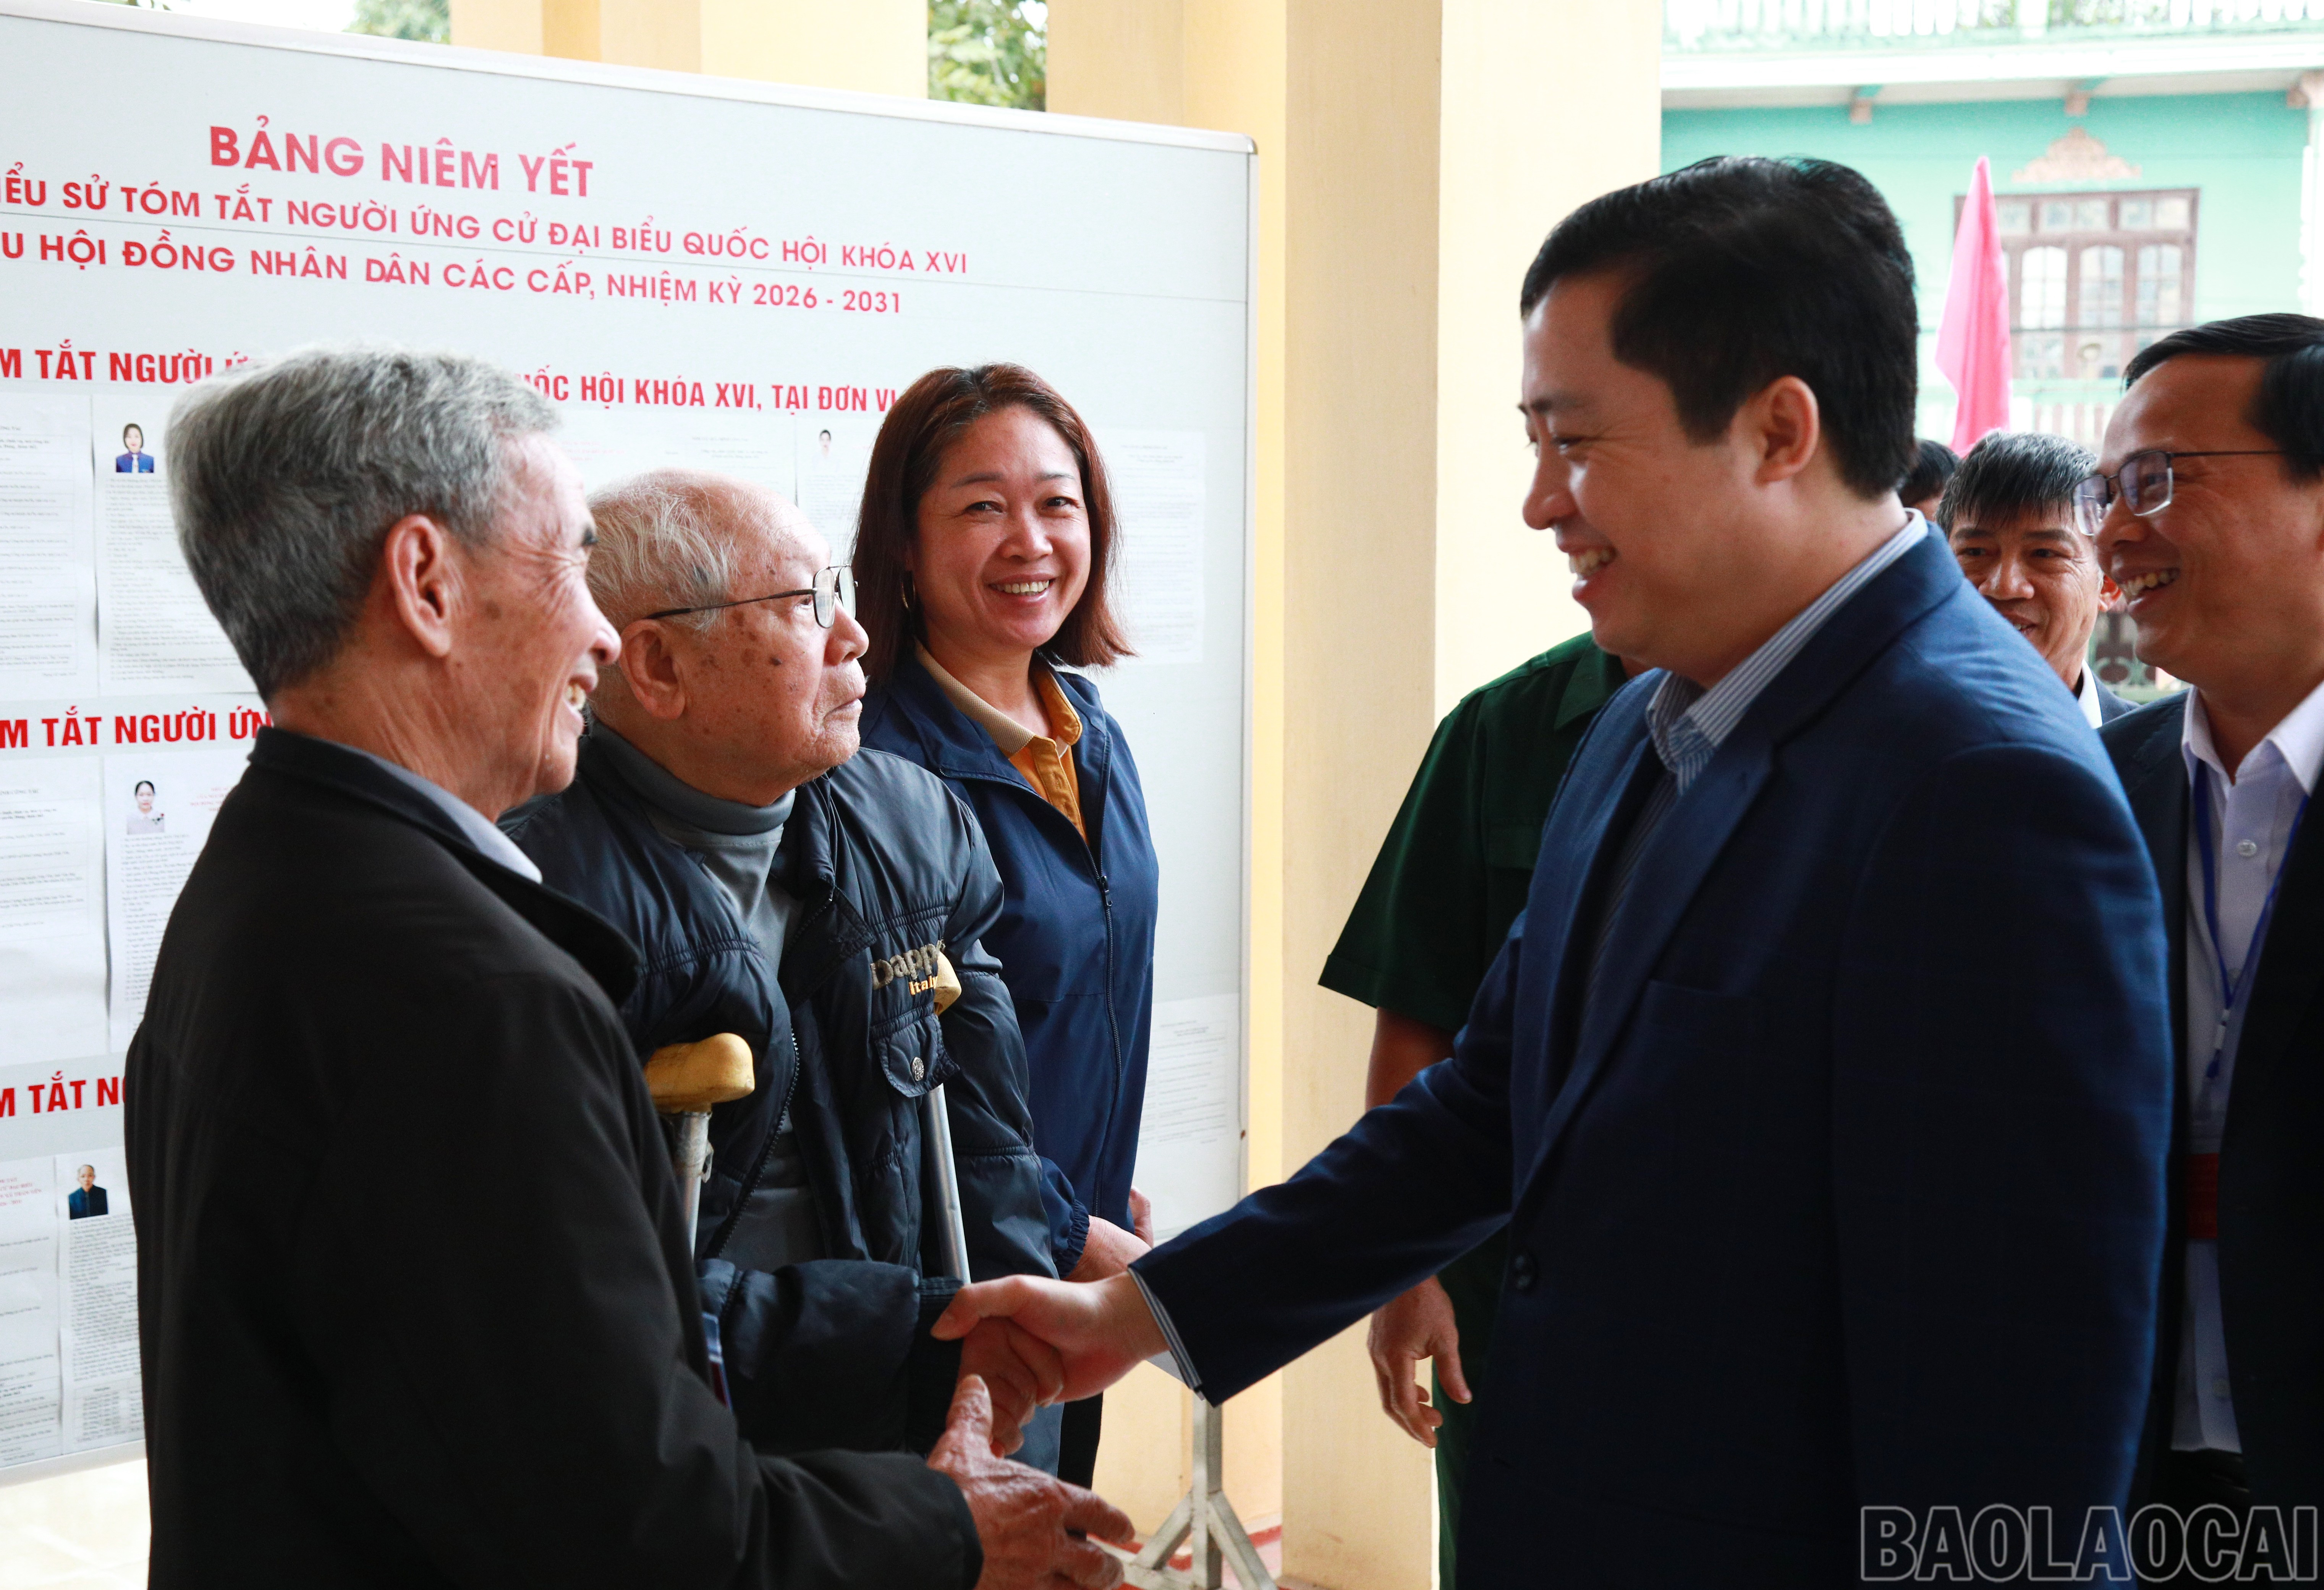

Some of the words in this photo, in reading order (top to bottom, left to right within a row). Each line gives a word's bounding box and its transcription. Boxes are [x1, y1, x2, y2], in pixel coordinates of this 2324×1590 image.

[210, 115, 363, 176] BẢNG
[382, 138, 498, 189] NIÊM
[520, 143, 593, 196] YẾT
[0, 162, 46, 206] ỂU
[63, 174, 109, 210] SỬ
[121, 181, 200, 217] TÓM
[215, 183, 273, 222] TẮT
[288, 200, 396, 232] NGƯỜI
[411, 205, 480, 238] ỨNG
[493, 212, 537, 243] CỬ
[548, 223, 599, 254] ĐẠI
[613, 214, 671, 252] BIỂU
[683, 226, 769, 259] QUỐC
[783, 236, 826, 269] HỘI
[843, 243, 914, 270] KHÓA
[926, 252, 966, 273] XVI
[40, 229, 106, 270] HỘI
[122, 229, 235, 272] ĐỒNG
[251, 246, 346, 279] NHÂN
[366, 252, 429, 285] DÂN
[443, 259, 514, 290] CÁC
[528, 260, 594, 299] CẤP,
[608, 270, 696, 306] NHIỆM
[710, 281, 741, 303] KỲ
[754, 283, 817, 308] 2026
[843, 290, 898, 312] 2031
[35, 339, 96, 380] TẮT
[110, 349, 212, 383] NGƯỜI
[515, 365, 568, 401] ỐC
[581, 371, 623, 409] HỘI
[636, 376, 705, 406] KHÓA
[715, 383, 761, 411] XVI,
[772, 385, 808, 415] TẠI
[818, 385, 866, 411] ĐƠN
[41, 705, 102, 747] TẮT
[115, 706, 216, 744] NGƯỜI
[28, 1071, 86, 1113] TẮT
